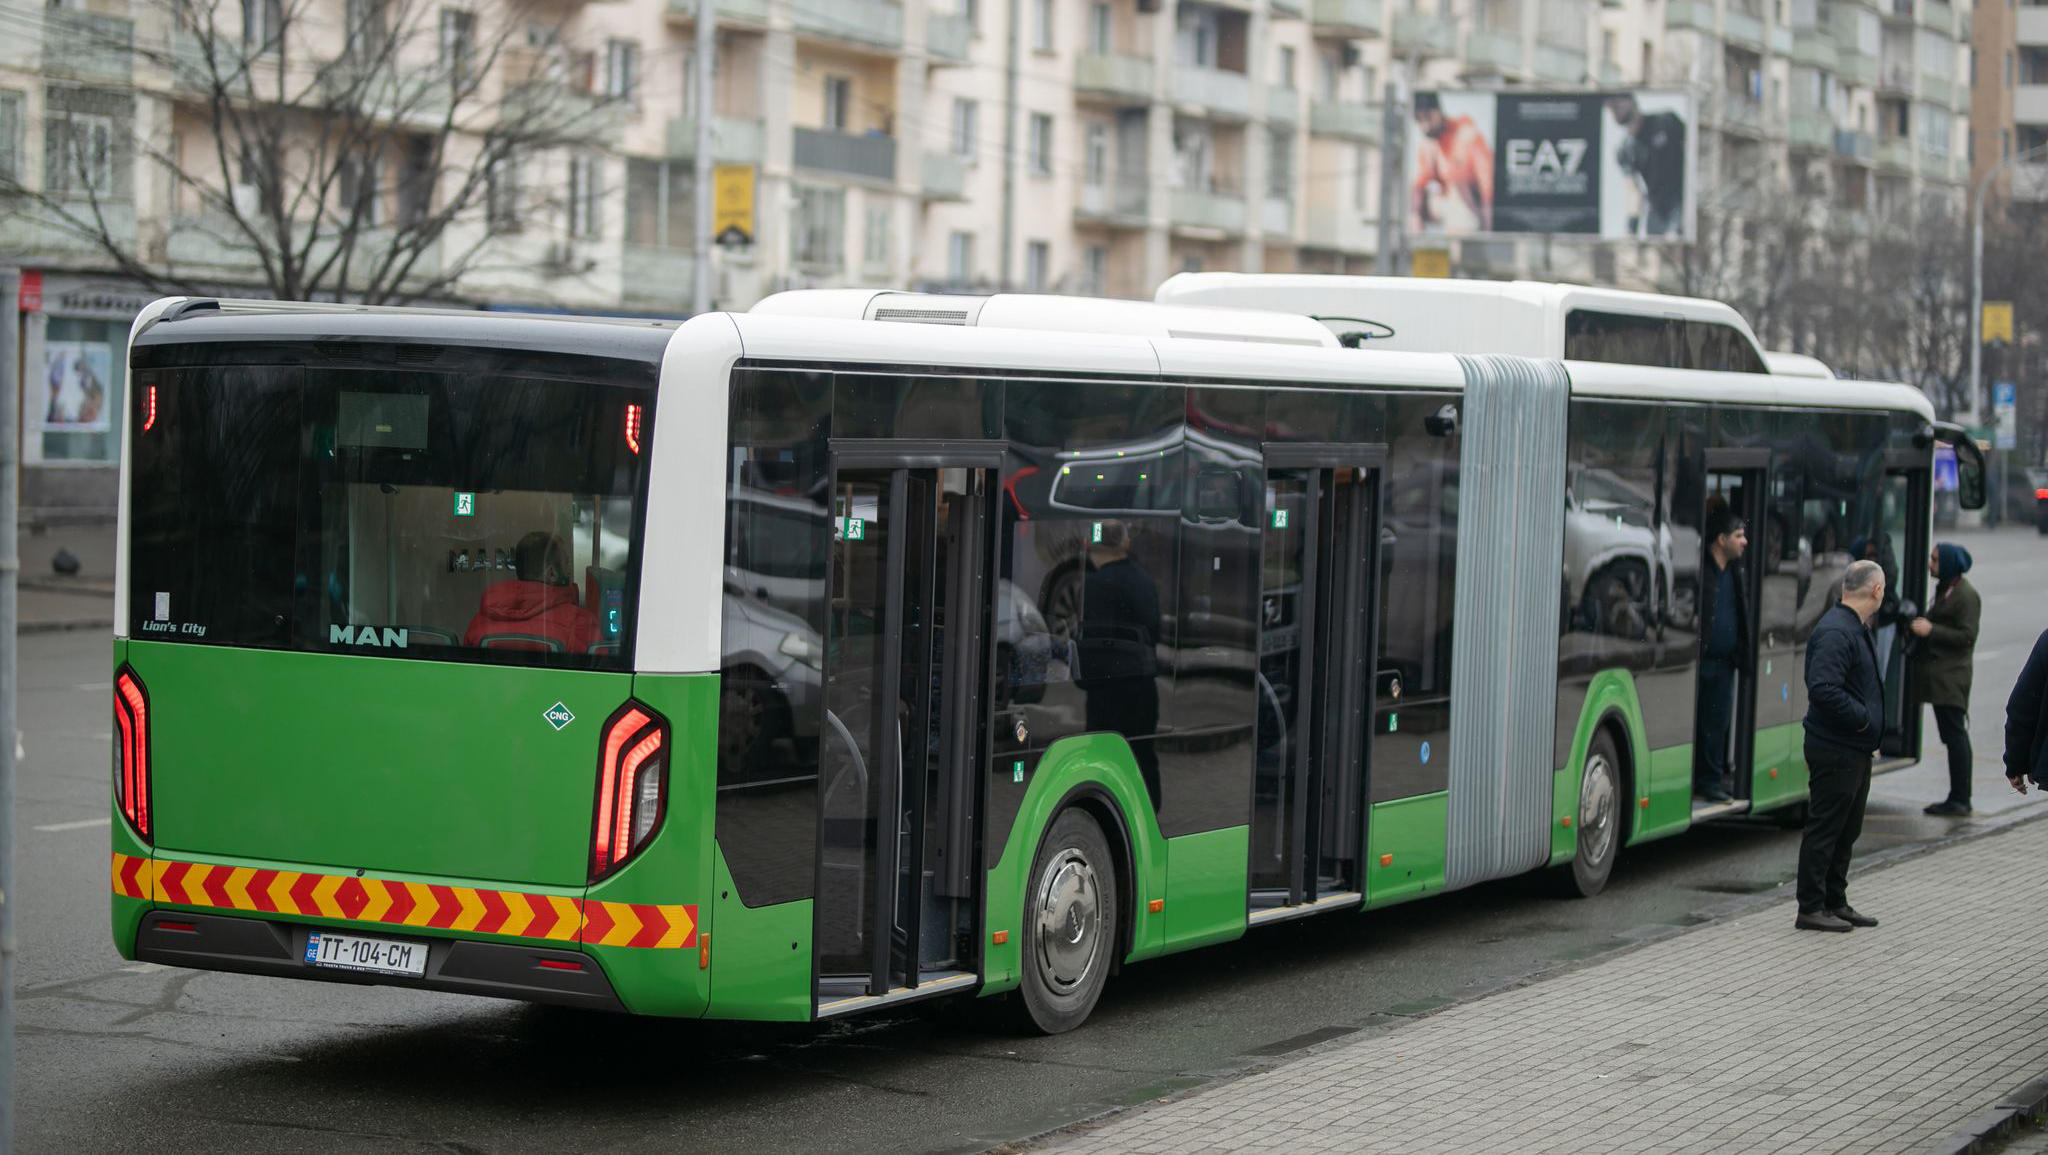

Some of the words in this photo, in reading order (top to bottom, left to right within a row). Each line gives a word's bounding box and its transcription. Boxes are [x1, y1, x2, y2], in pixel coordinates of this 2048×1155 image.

[1506, 138, 1588, 176] EA7
[143, 620, 177, 632] Lion's
[182, 623, 207, 636] City
[330, 624, 408, 648] MAN
[550, 711, 569, 721] CNG
[307, 948, 317, 959] GE
[322, 937, 412, 968] TT-104-CM
